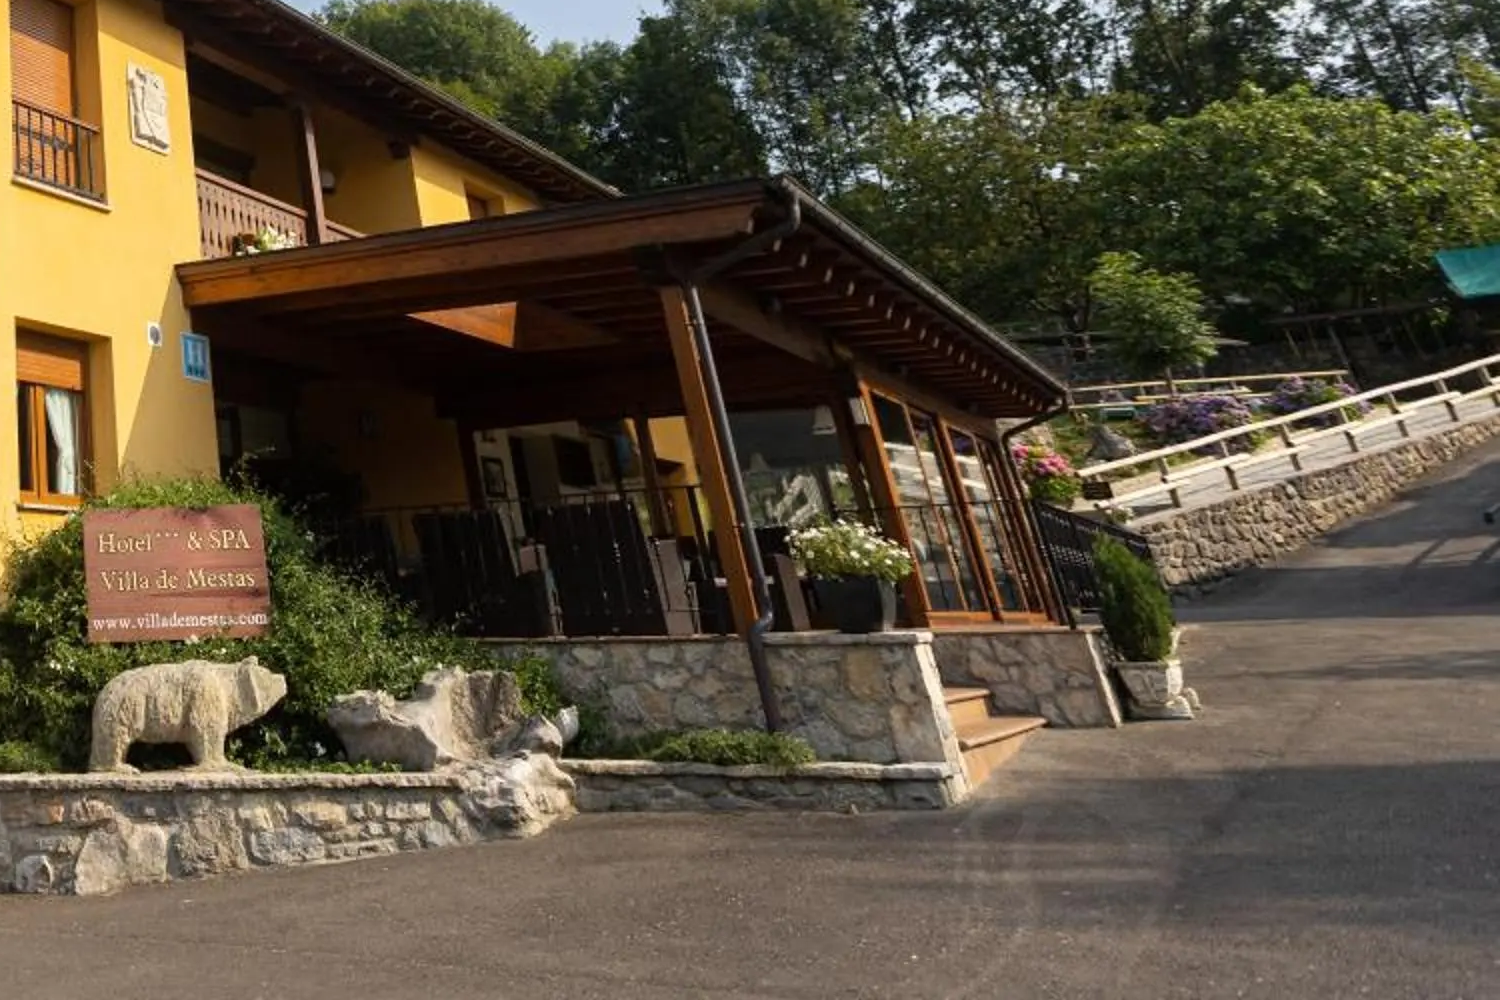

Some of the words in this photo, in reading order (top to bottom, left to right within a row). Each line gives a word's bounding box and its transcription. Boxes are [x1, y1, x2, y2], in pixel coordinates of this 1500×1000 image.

[187, 530, 202, 551] &
[209, 529, 251, 549] SPA
[100, 570, 149, 592] Villa
[156, 569, 179, 589] de
[187, 568, 255, 588] Mestas
